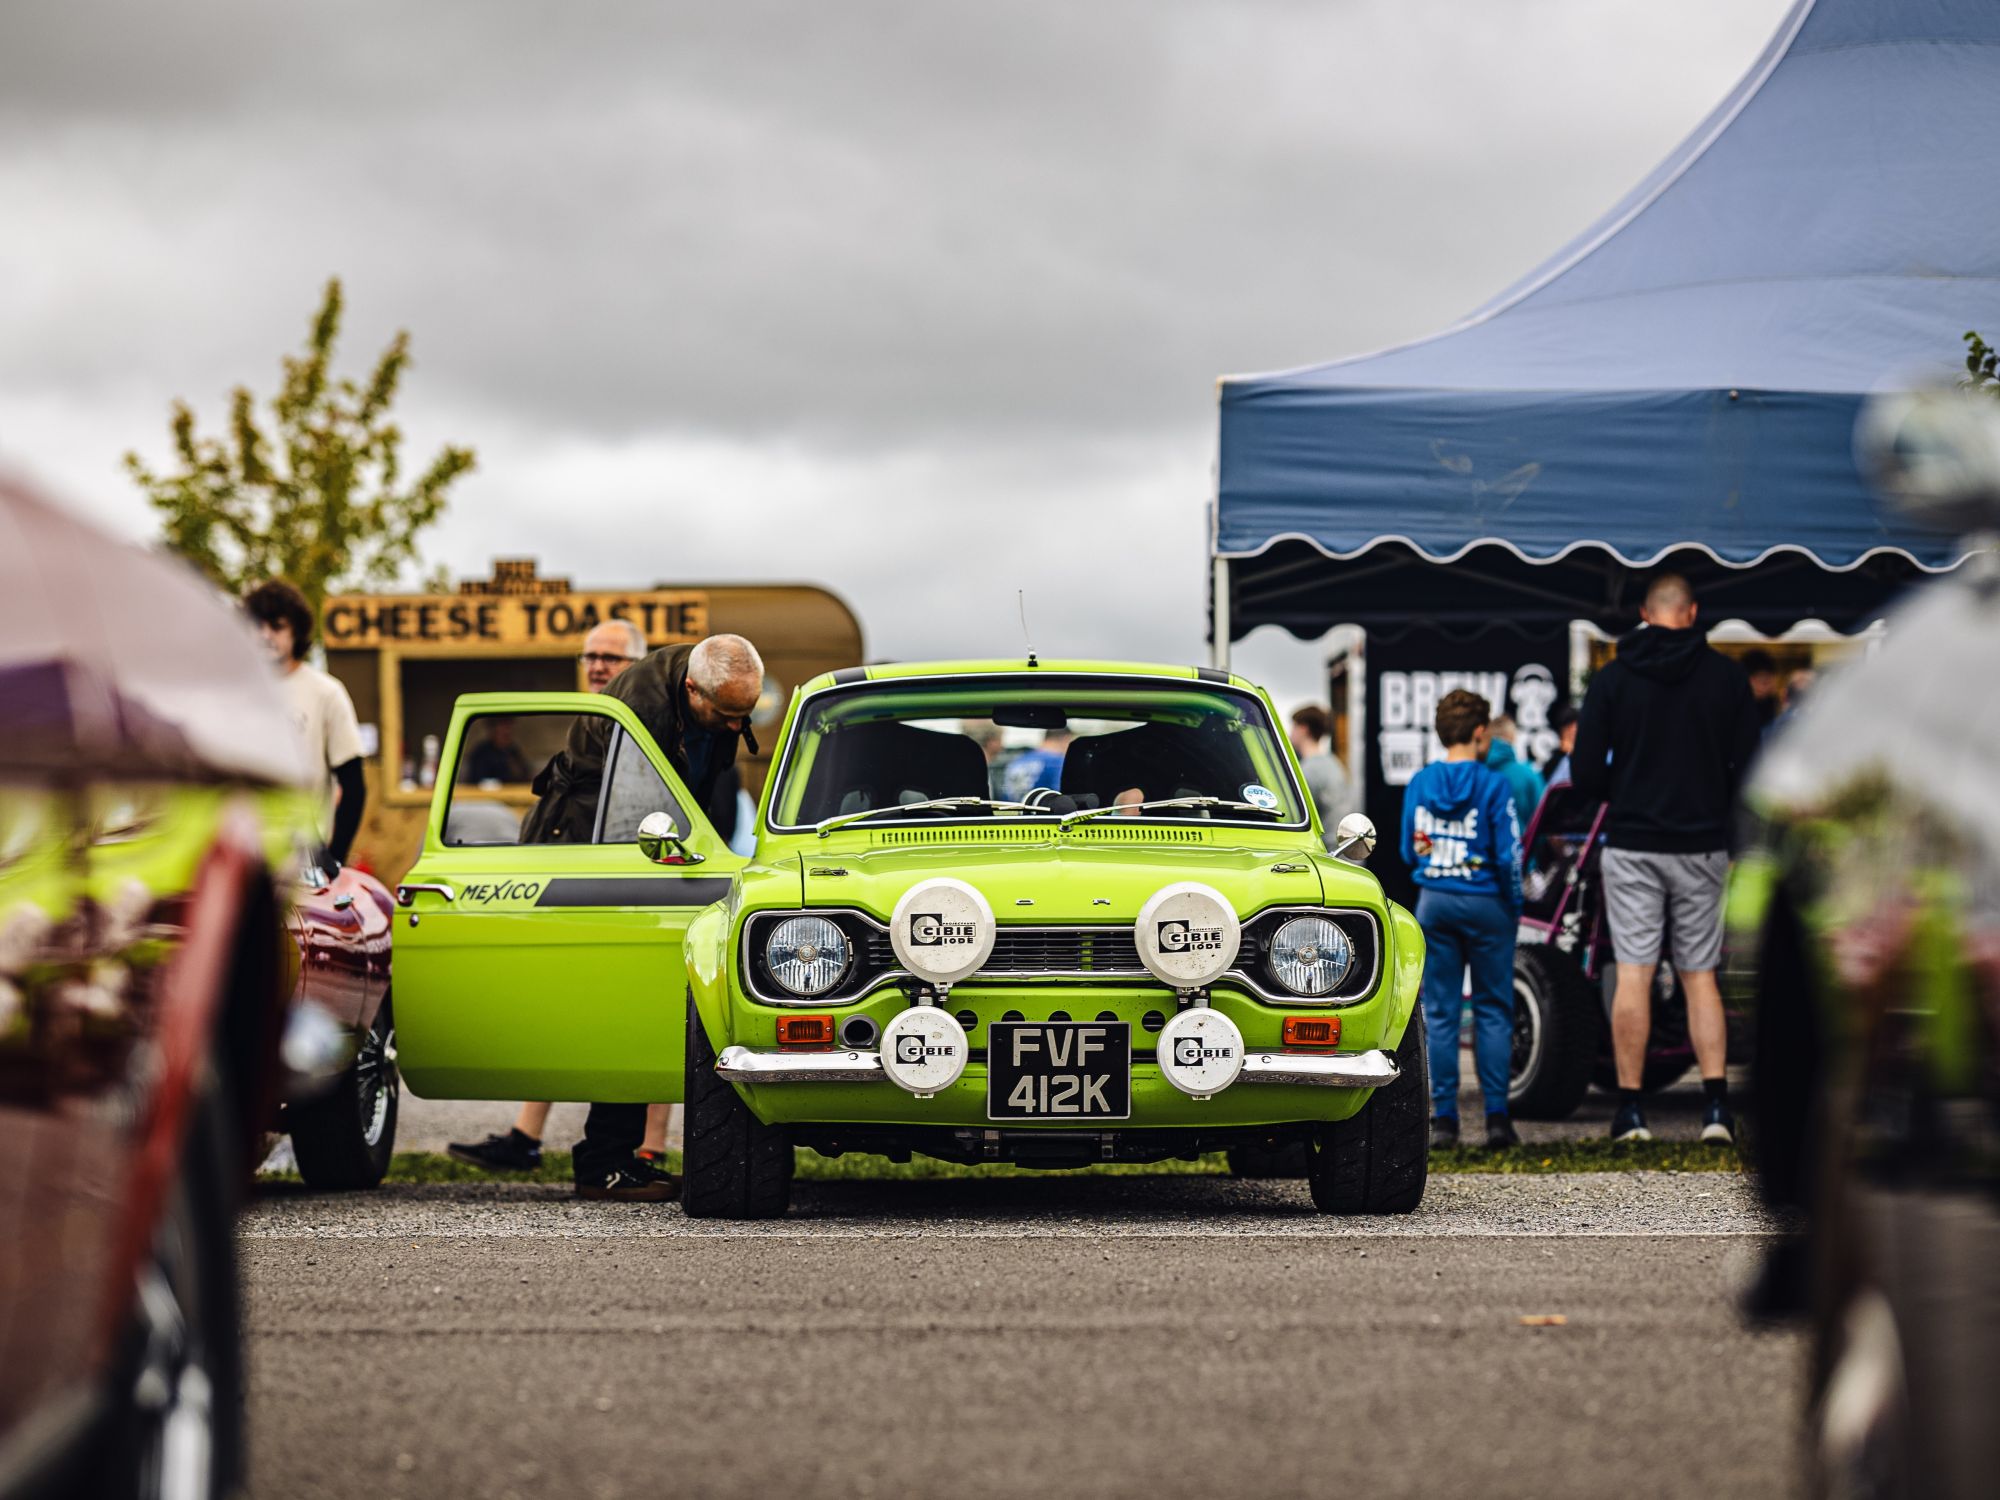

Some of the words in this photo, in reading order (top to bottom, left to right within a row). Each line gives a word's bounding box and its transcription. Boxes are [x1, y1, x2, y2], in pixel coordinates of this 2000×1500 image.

[326, 603, 499, 639] CHEESE
[459, 879, 540, 904] MEXICO
[923, 926, 974, 936] CIBIE
[1170, 932, 1221, 943] CIBIE
[907, 1047, 953, 1055] CIBIE
[1012, 1028, 1106, 1067] FVF
[1185, 1049, 1231, 1058] CIBIE
[1007, 1074, 1111, 1113] 412K
